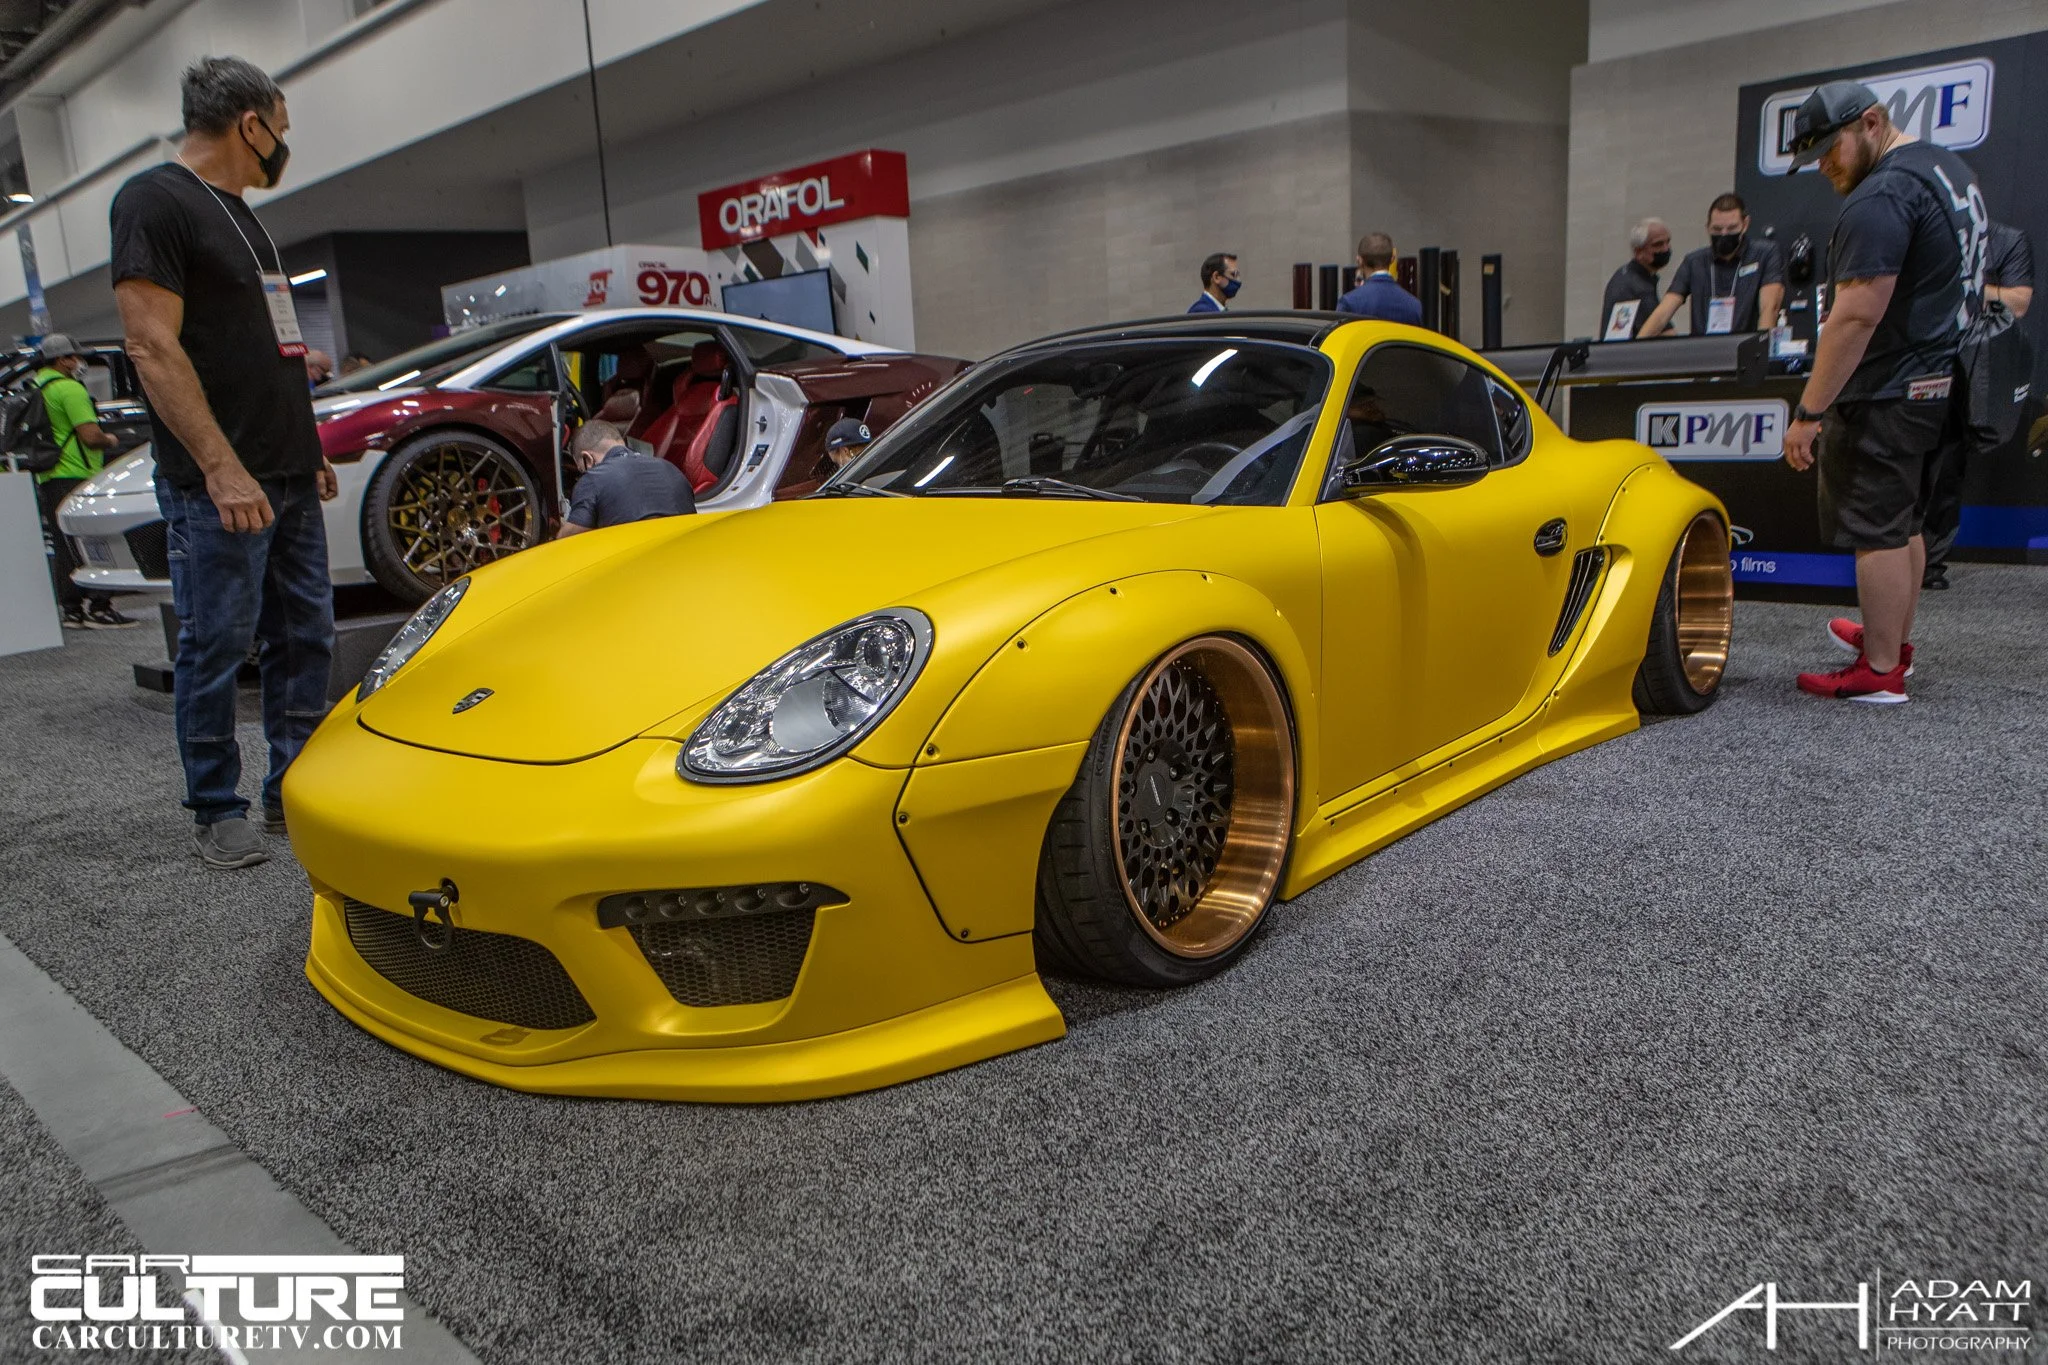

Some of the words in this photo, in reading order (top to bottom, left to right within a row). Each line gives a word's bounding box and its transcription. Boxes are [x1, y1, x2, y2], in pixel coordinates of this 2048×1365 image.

[719, 176, 845, 234] ORAFOL
[637, 270, 710, 305] 970
[1649, 411, 1776, 456] KPMF
[1741, 556, 1776, 573] films
